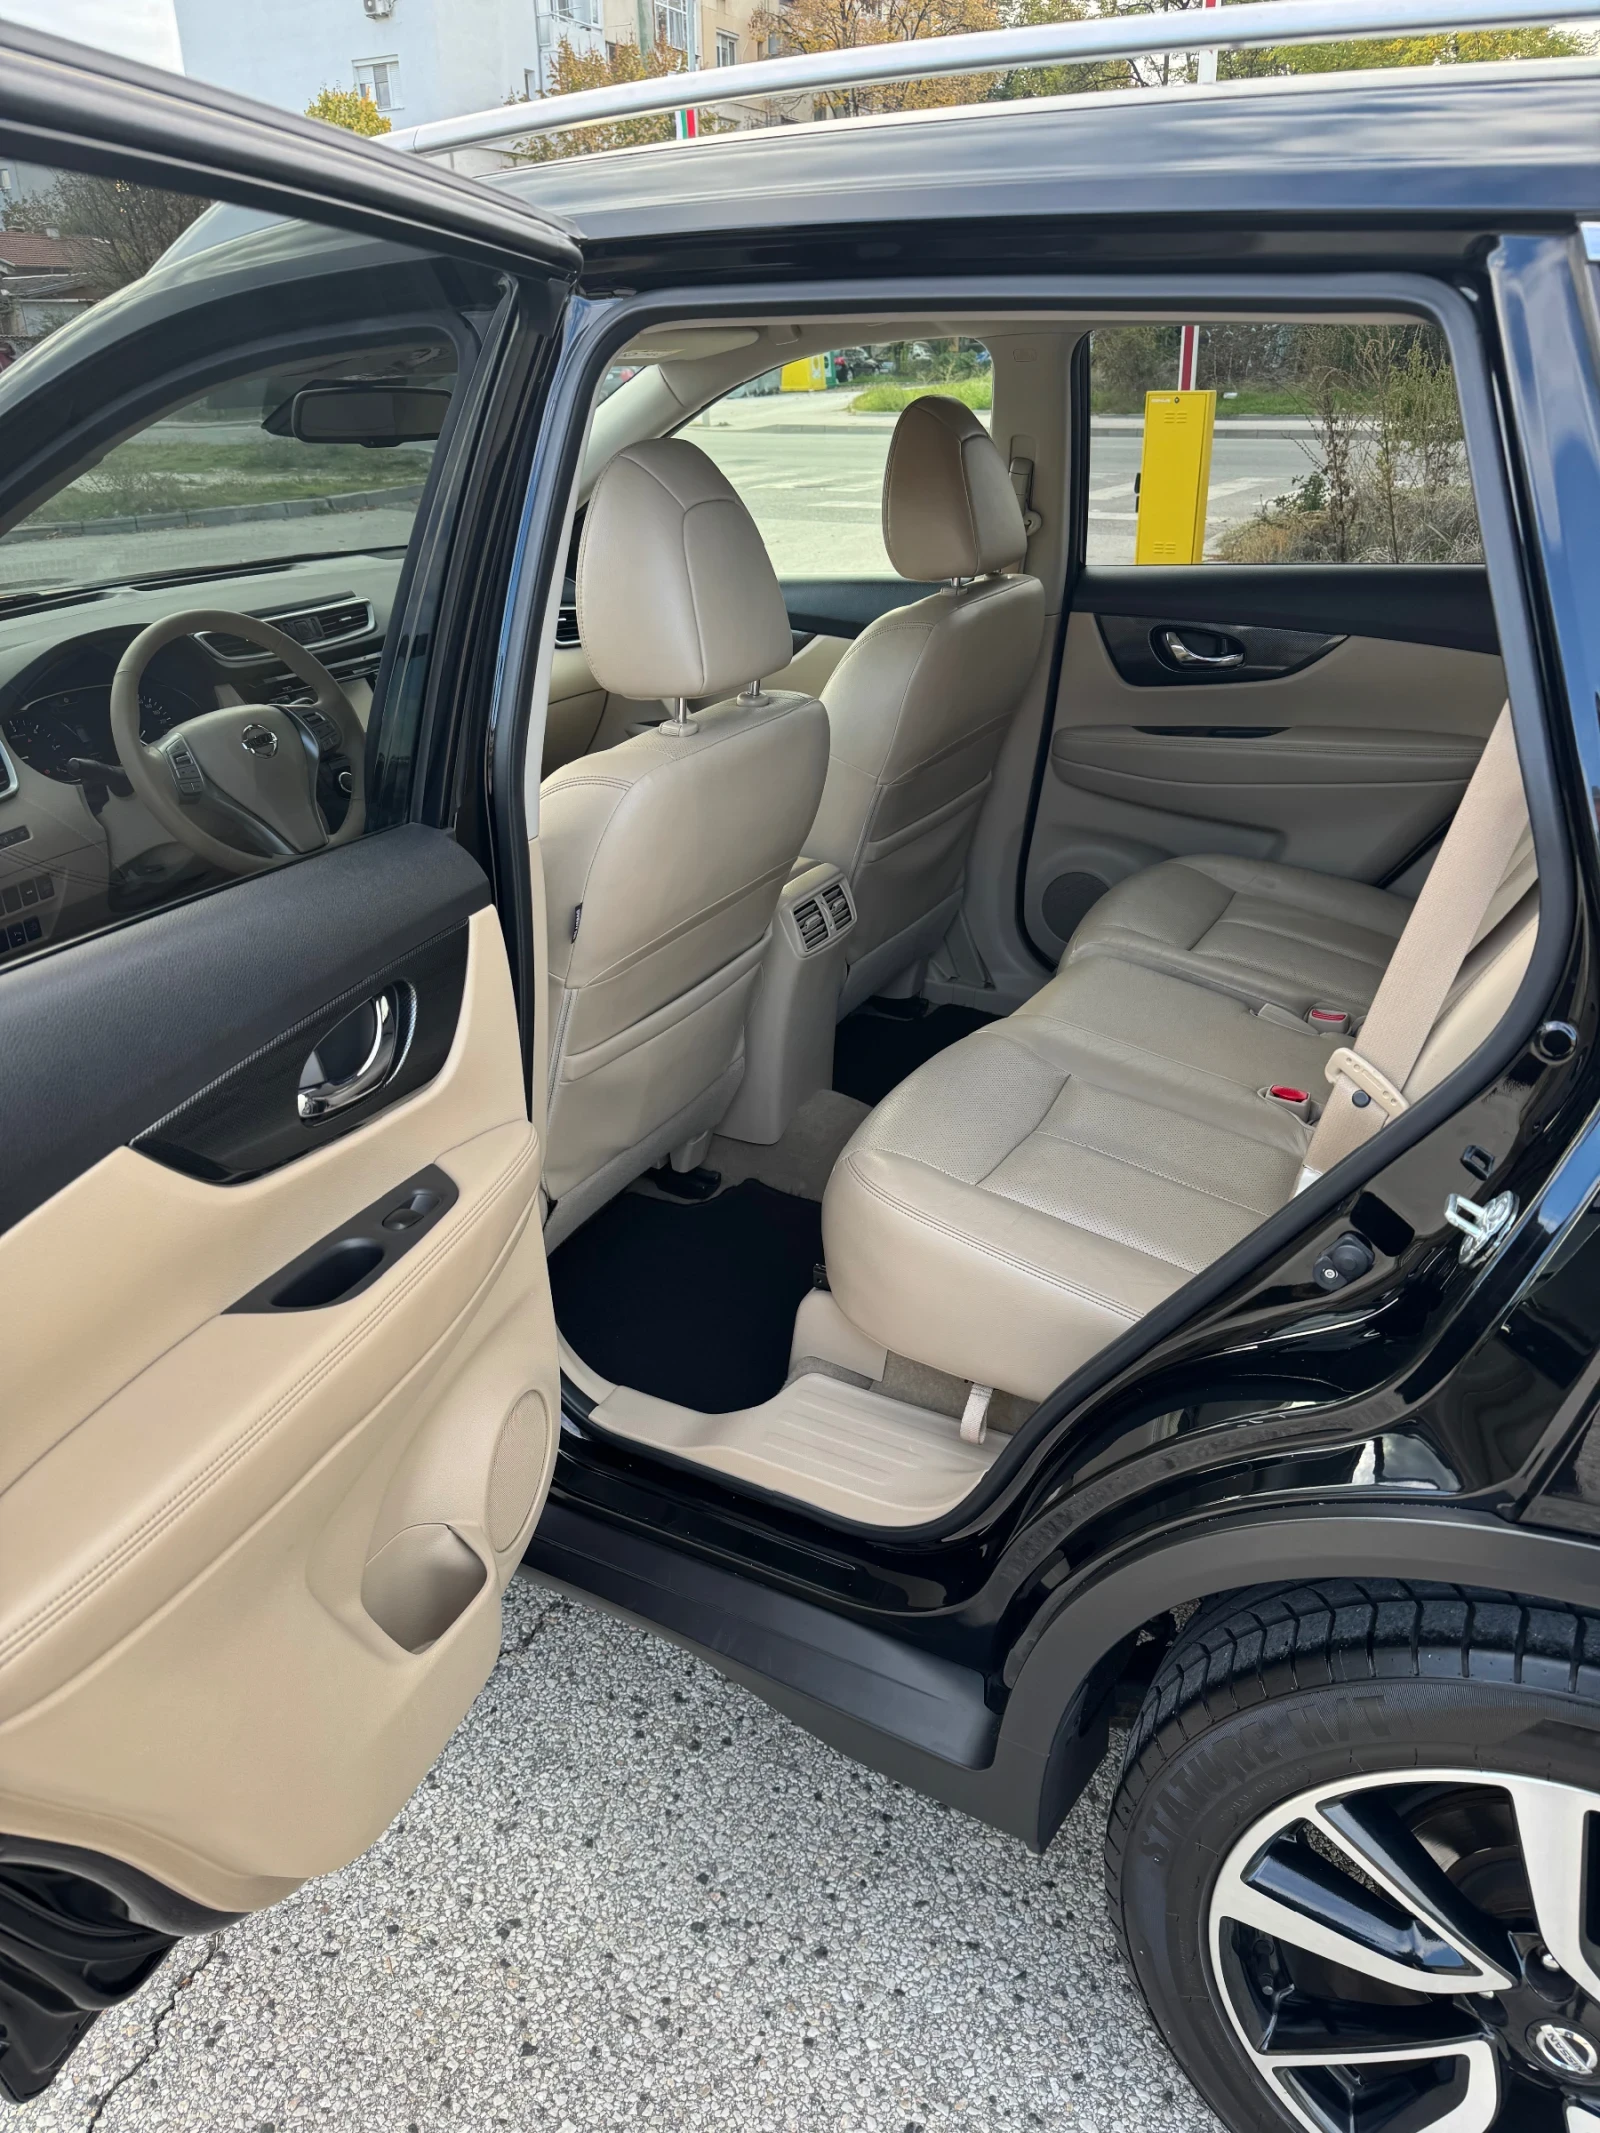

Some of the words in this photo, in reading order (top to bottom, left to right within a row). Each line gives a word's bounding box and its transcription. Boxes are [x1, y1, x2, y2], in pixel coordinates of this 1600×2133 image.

[1140, 1721, 1283, 1863] STATURE
[1287, 1695, 1391, 1748] H/T
[1547, 2031, 1583, 2072] NISSAN
